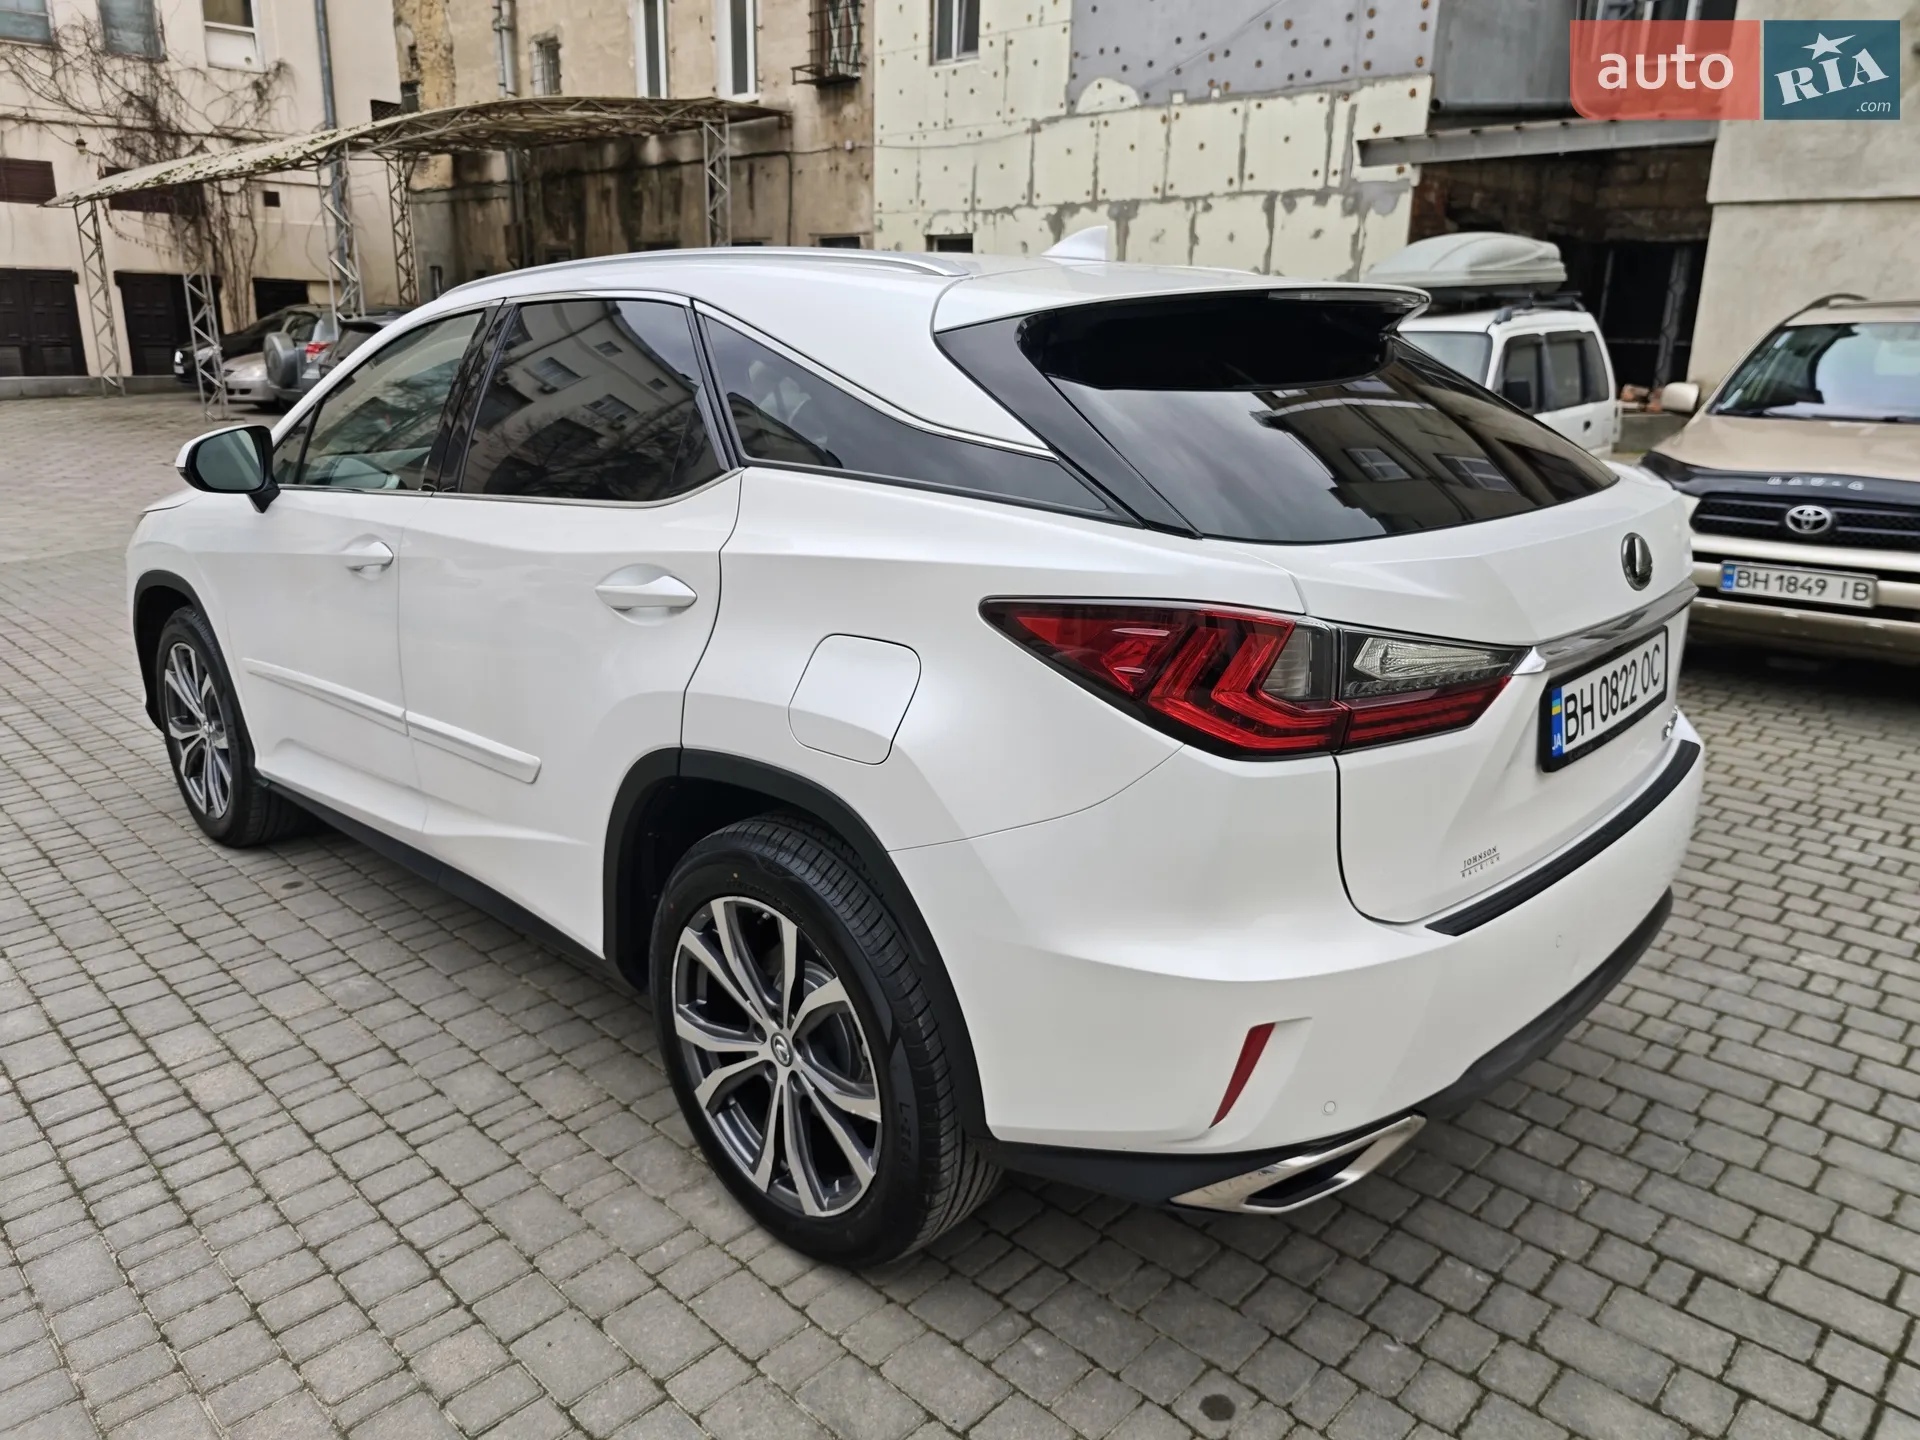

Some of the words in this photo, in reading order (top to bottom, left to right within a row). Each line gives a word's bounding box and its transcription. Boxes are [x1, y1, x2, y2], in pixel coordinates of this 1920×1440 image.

[1736, 570, 1769, 590] BH
[1775, 575, 1827, 596] 1849
[1840, 581, 1869, 601] IB
[1564, 683, 1595, 745] BH
[1599, 659, 1637, 723] 0822
[1641, 643, 1660, 695] OC
[1463, 845, 1498, 868] JOHNSON
